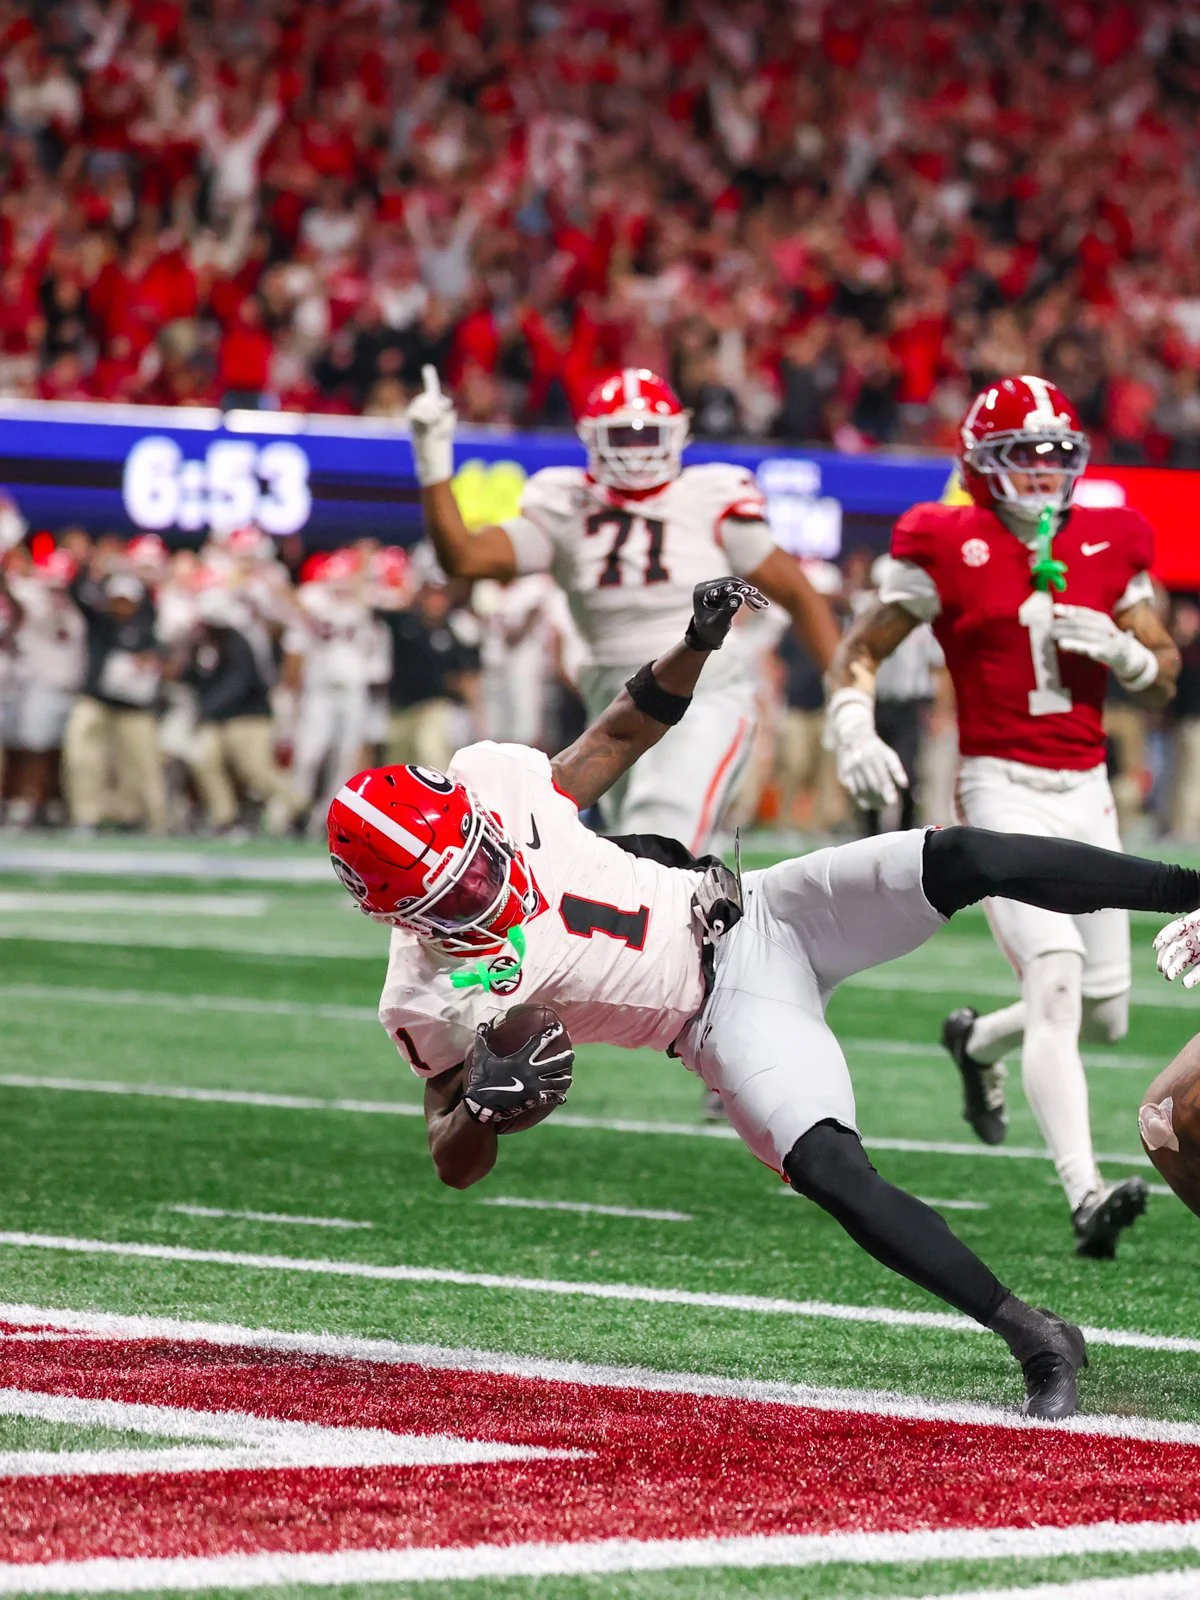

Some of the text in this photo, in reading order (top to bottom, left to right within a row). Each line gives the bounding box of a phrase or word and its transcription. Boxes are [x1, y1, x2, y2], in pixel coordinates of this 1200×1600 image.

[122, 436, 312, 535] 6:53
[586, 510, 670, 588] 71
[1018, 590, 1074, 717] 1
[558, 892, 650, 951] 1
[396, 1027, 431, 1071] 1
